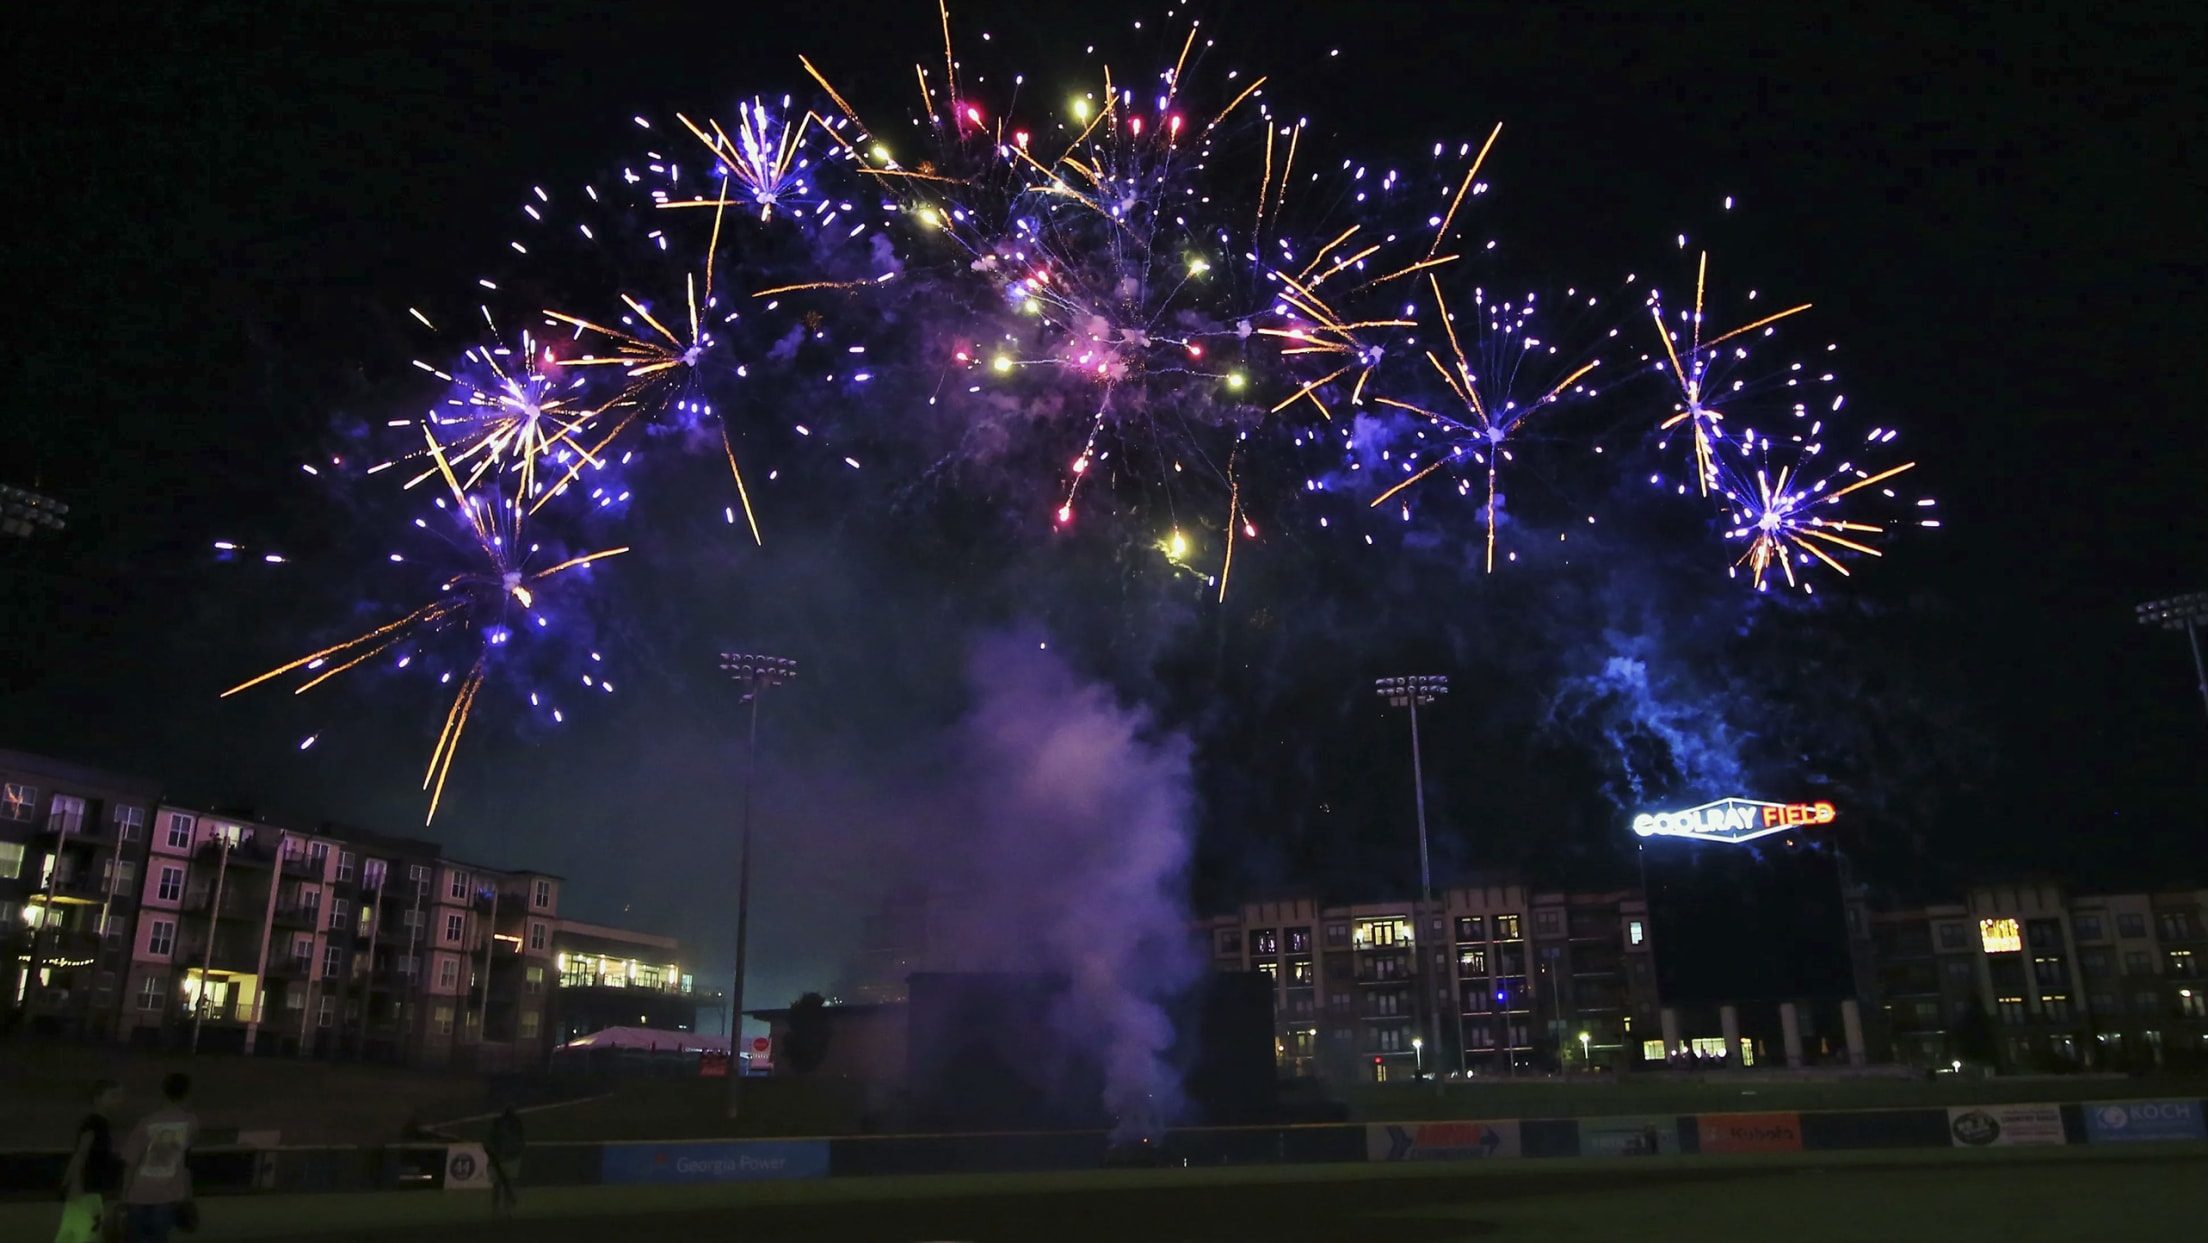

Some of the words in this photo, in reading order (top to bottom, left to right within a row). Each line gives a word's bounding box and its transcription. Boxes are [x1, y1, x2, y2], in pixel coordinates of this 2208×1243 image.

[1633, 807, 1757, 837] COOLRAY
[1762, 802, 1836, 828] FIELD
[2129, 1104, 2191, 1120] KOCH
[1730, 1126, 1794, 1141] Kubota
[676, 1156, 736, 1175] Georgia
[740, 1154, 786, 1170] Power
